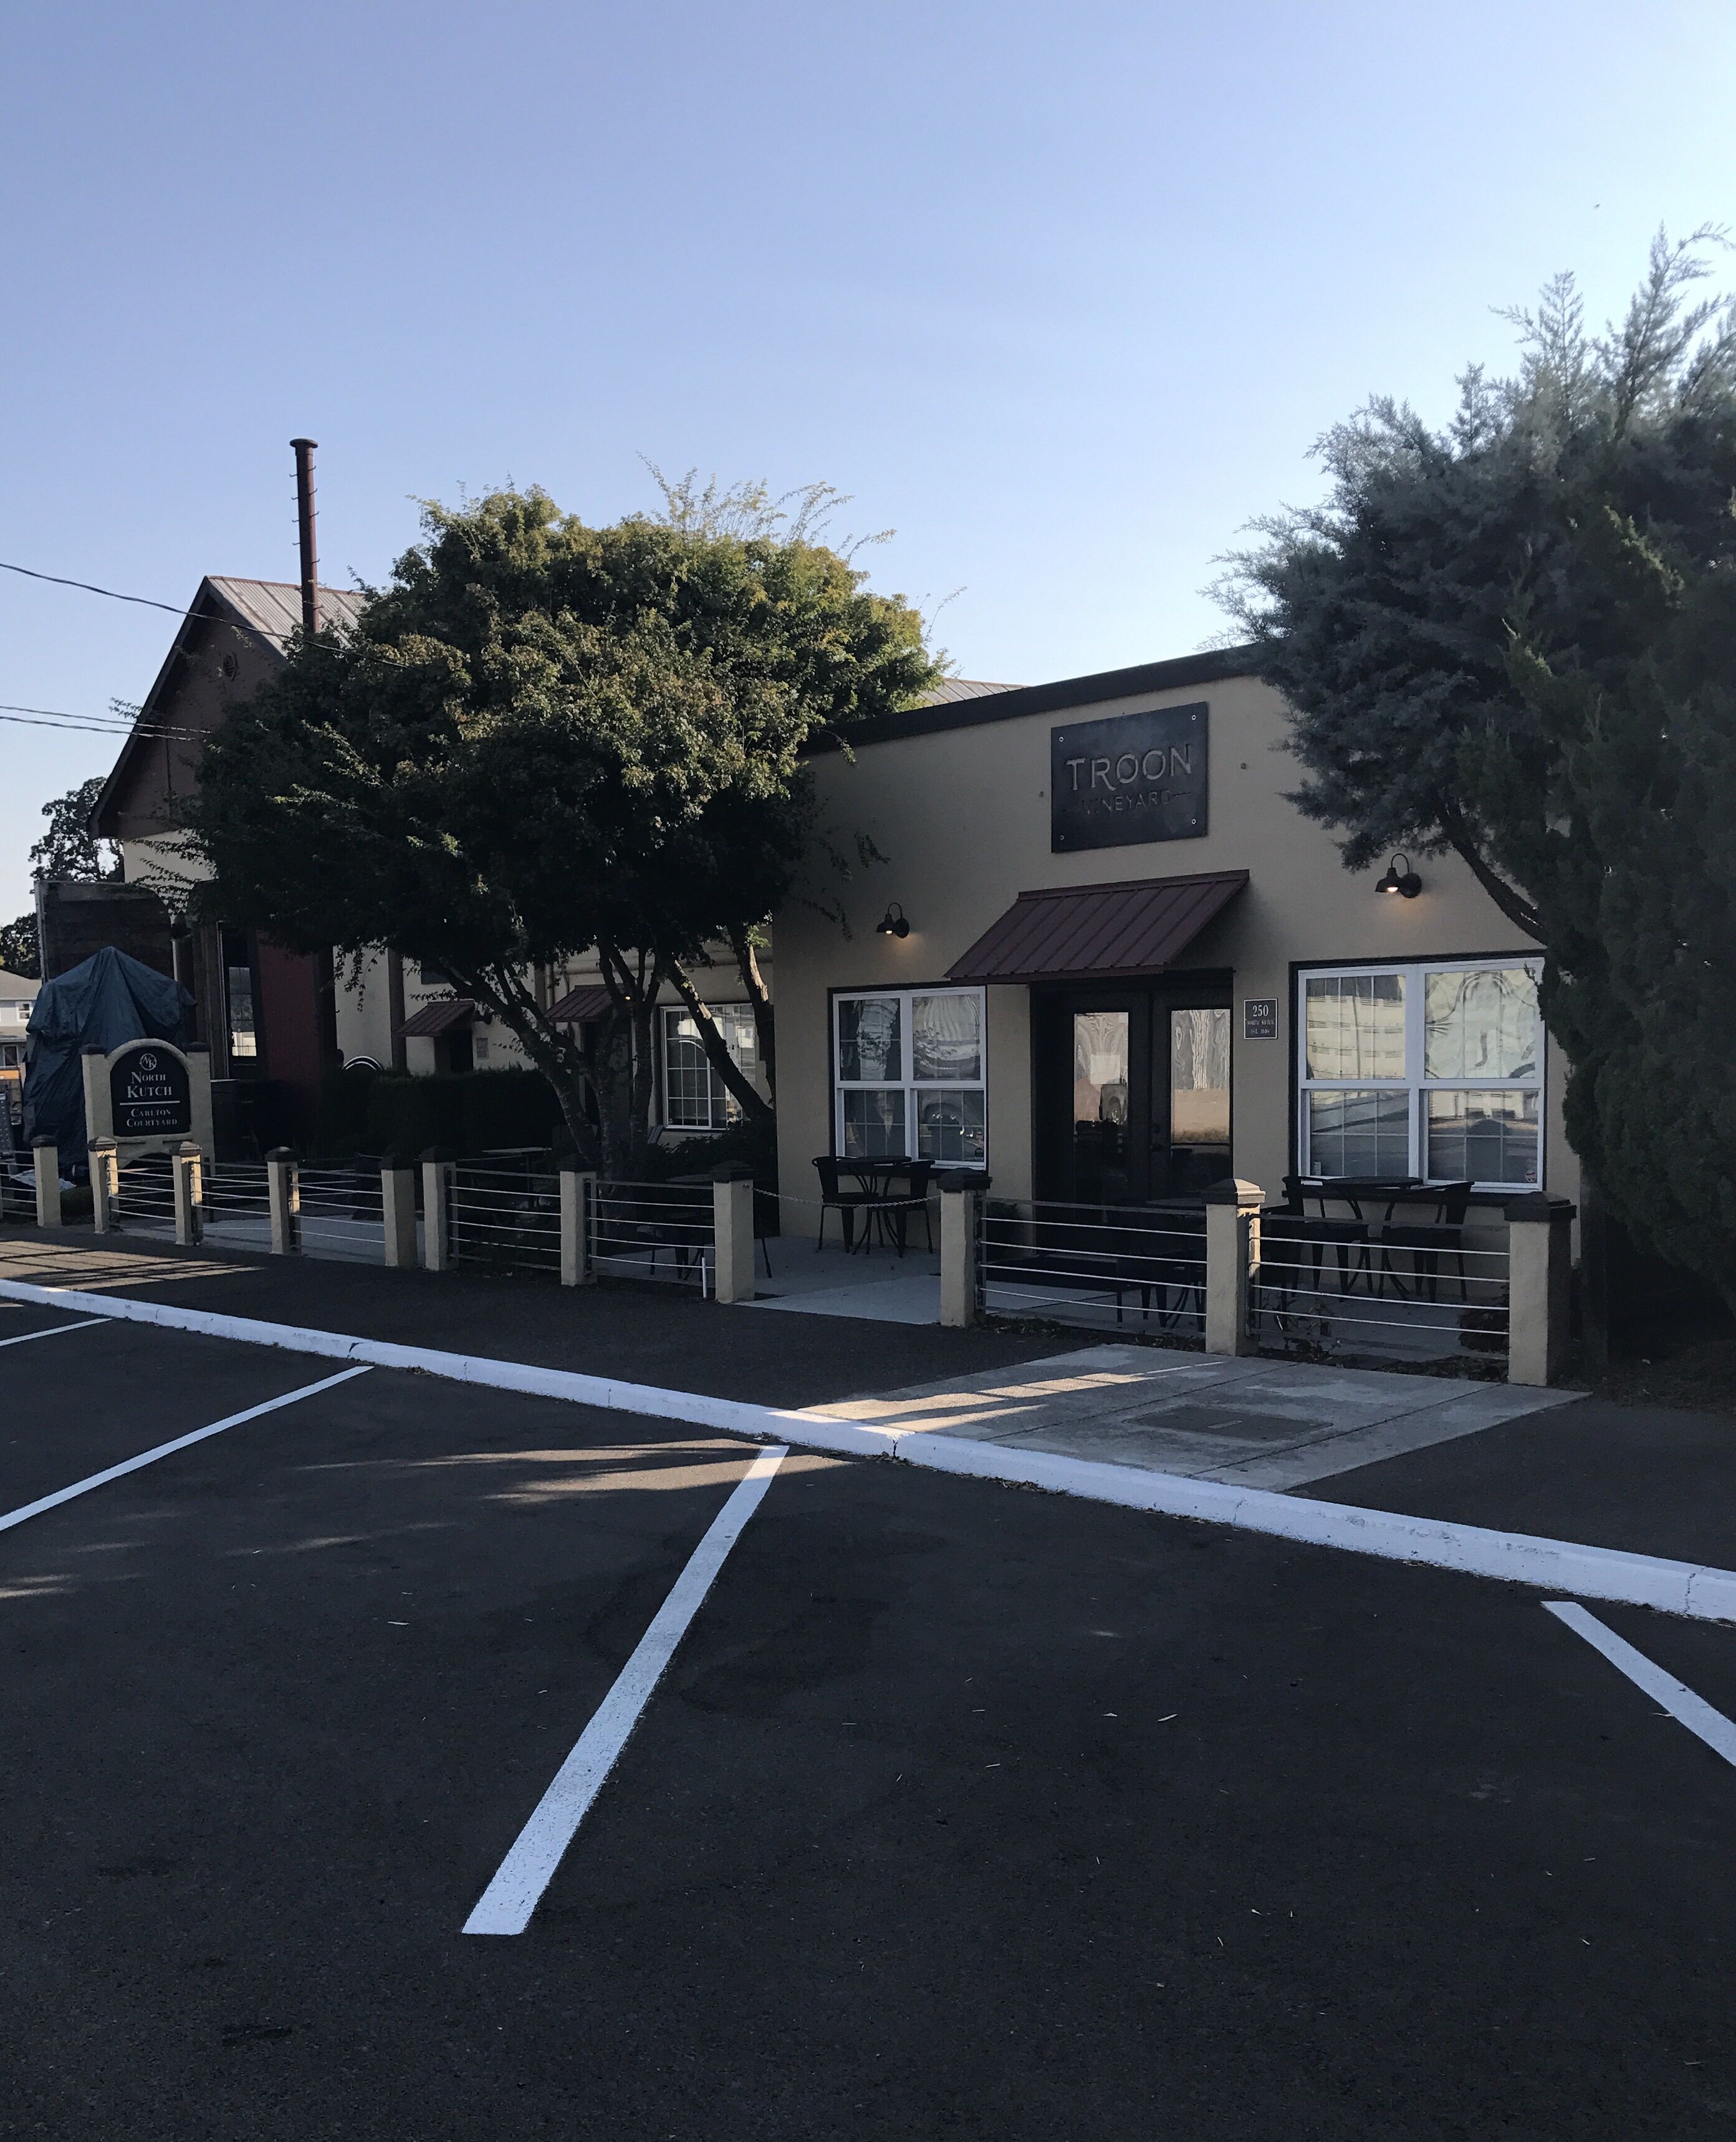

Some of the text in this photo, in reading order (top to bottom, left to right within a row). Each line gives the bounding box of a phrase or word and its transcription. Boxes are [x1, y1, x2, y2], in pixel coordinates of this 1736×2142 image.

[1065, 744, 1191, 791] TROON
[1082, 789, 1171, 814] VINEYARD
[1253, 1004, 1268, 1017] 250
[131, 1072, 166, 1083] NORTH
[127, 1085, 172, 1098] KUTCH
[131, 1108, 171, 1117] CARLTON
[126, 1118, 178, 1128] COURTYARD
